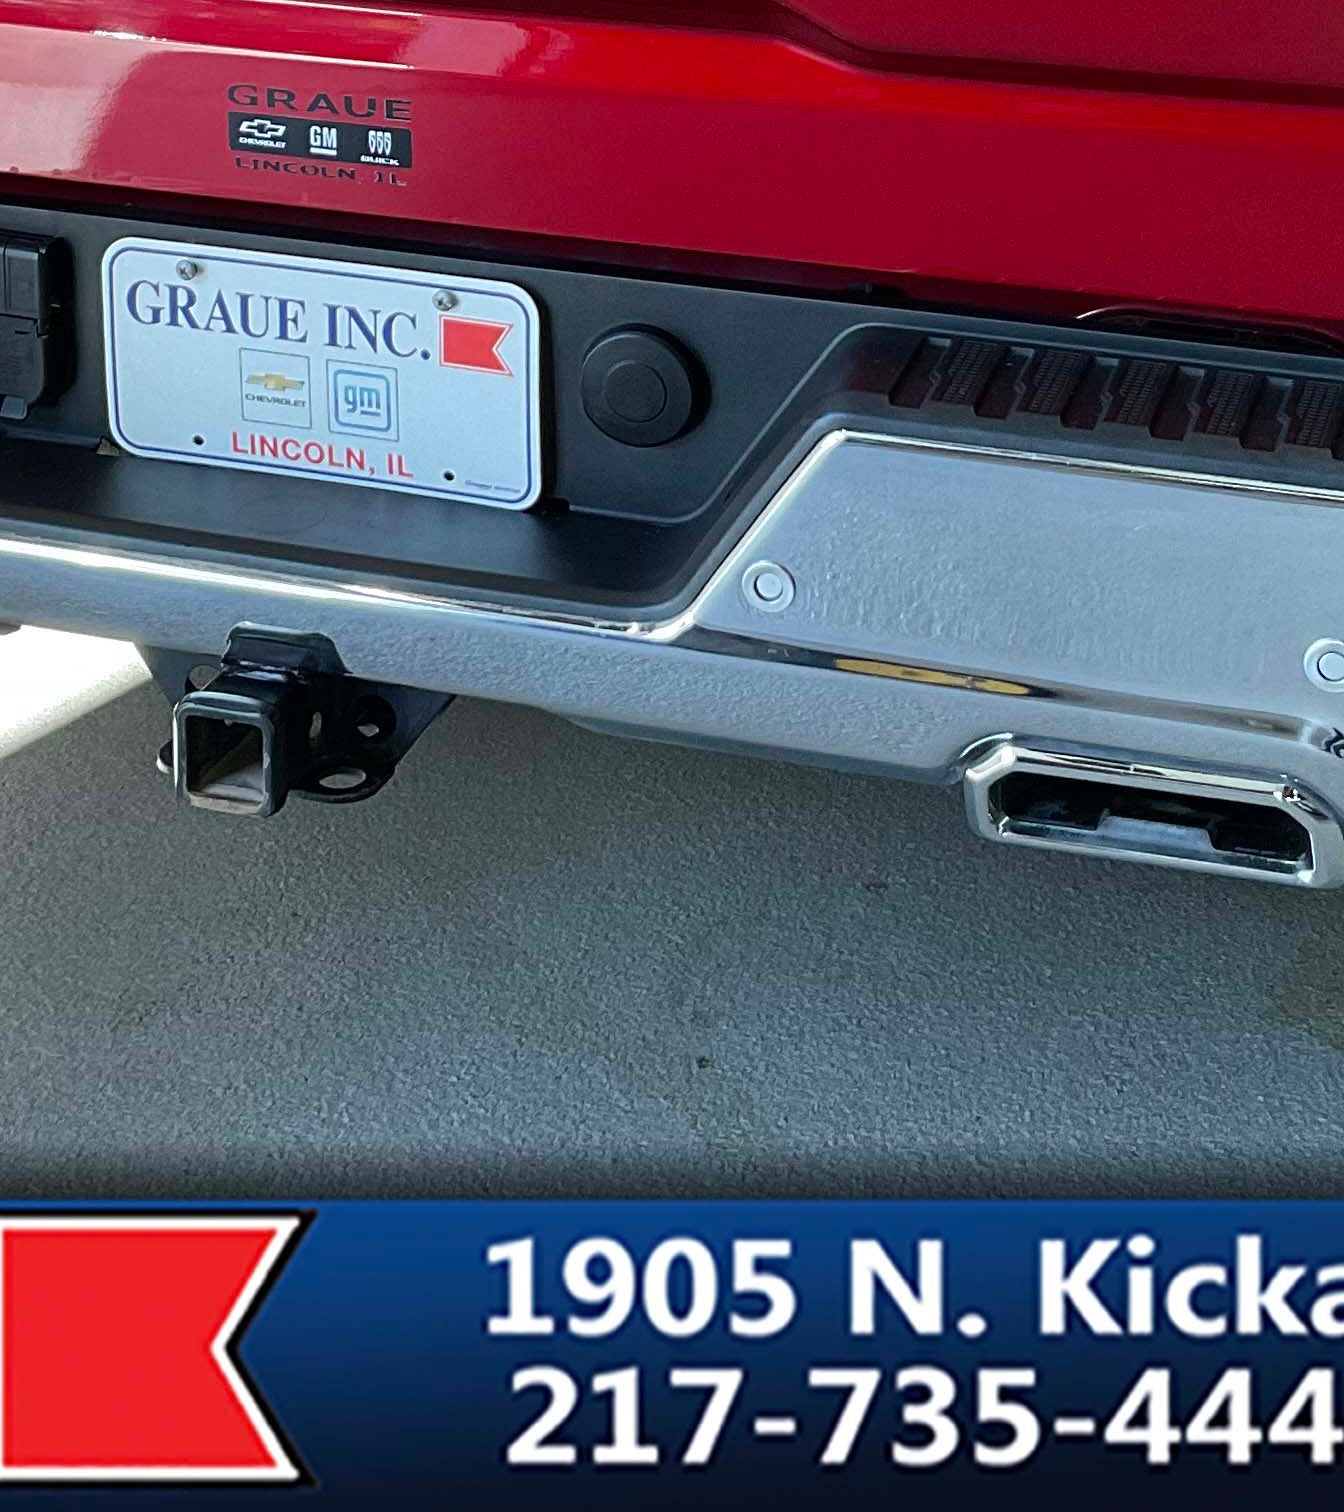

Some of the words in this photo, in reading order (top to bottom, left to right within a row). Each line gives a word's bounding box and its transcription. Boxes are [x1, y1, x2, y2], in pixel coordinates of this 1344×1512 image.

[227, 85, 412, 122] GRAUE
[239, 136, 287, 149] CHEVROLET
[310, 125, 337, 149] GM
[360, 155, 400, 166] BUICK
[375, 171, 407, 186] IL
[126, 280, 308, 344] GRAUE
[323, 302, 431, 361] INC.
[245, 393, 307, 408] CHEVROLET
[344, 385, 382, 414] gm
[232, 431, 376, 476] LINCOLN,
[387, 453, 414, 478] IL
